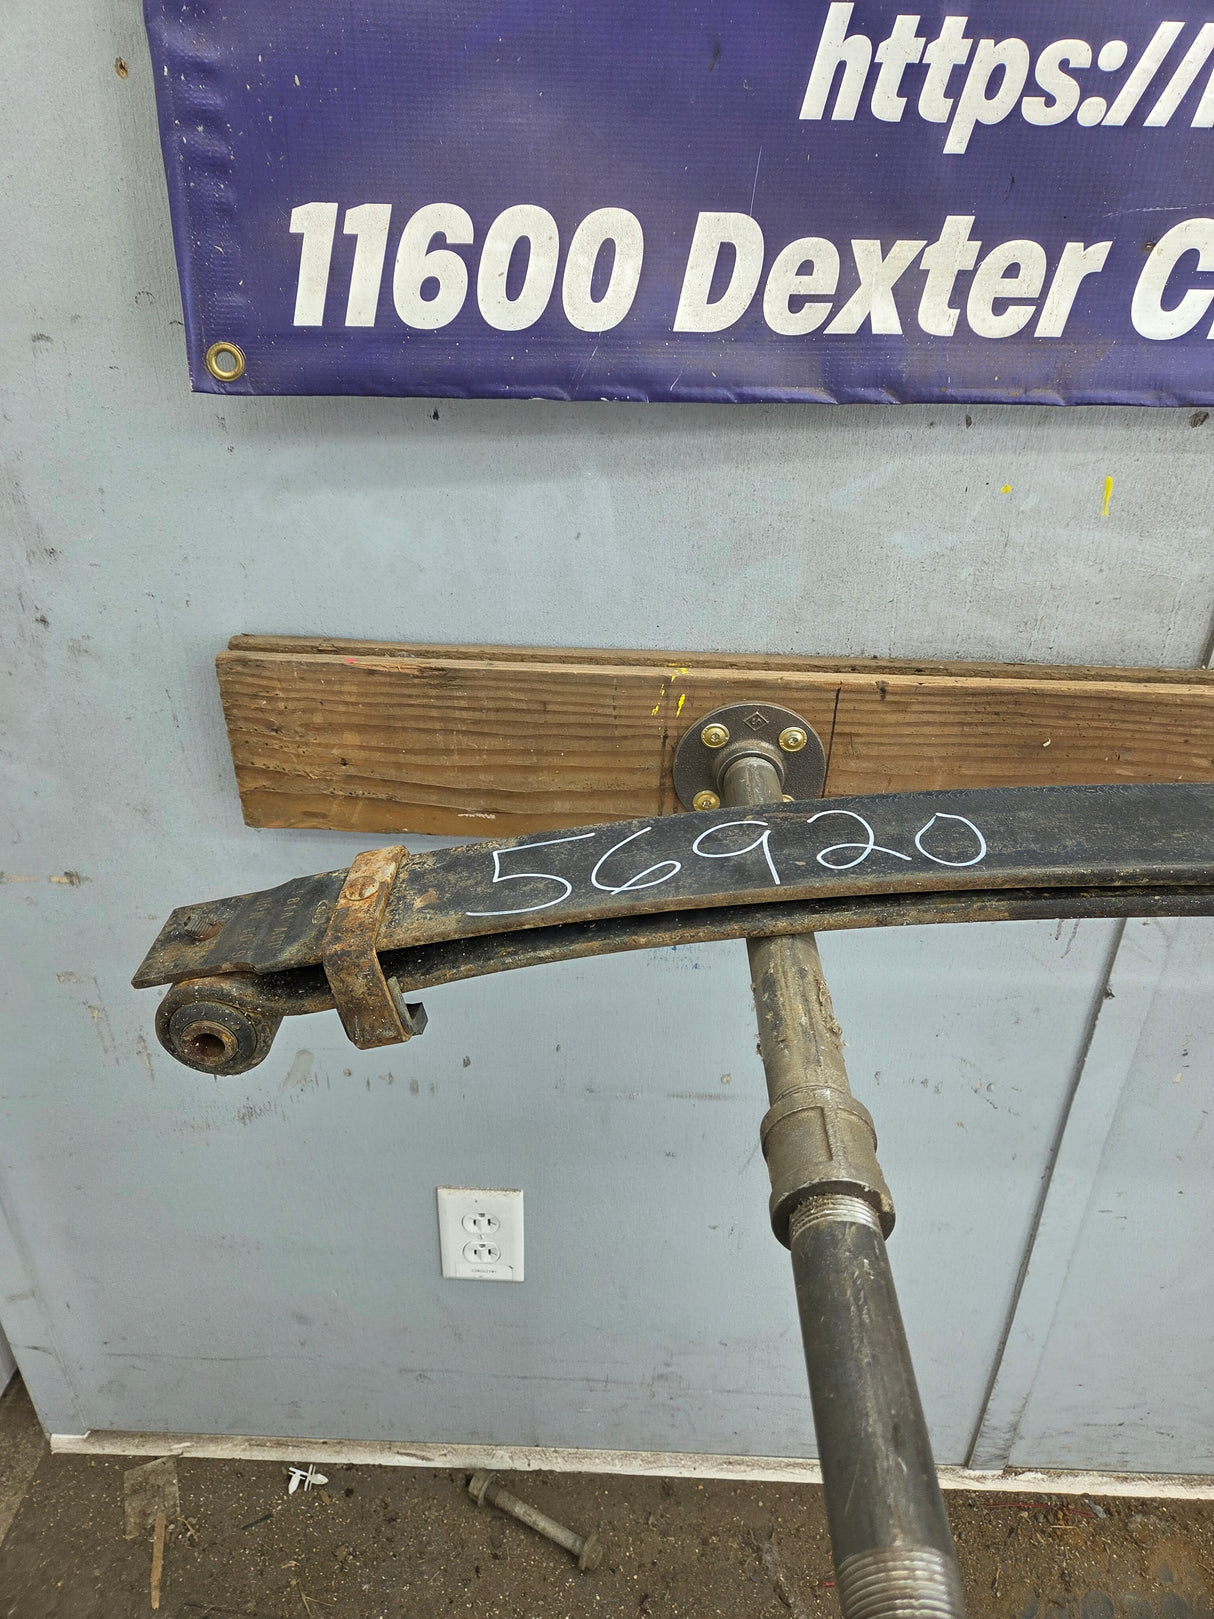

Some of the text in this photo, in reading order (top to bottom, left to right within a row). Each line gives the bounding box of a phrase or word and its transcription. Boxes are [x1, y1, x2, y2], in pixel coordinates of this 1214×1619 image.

[288, 202, 1214, 341] 11600 Dexter C
[465, 809, 987, 916] 56920
